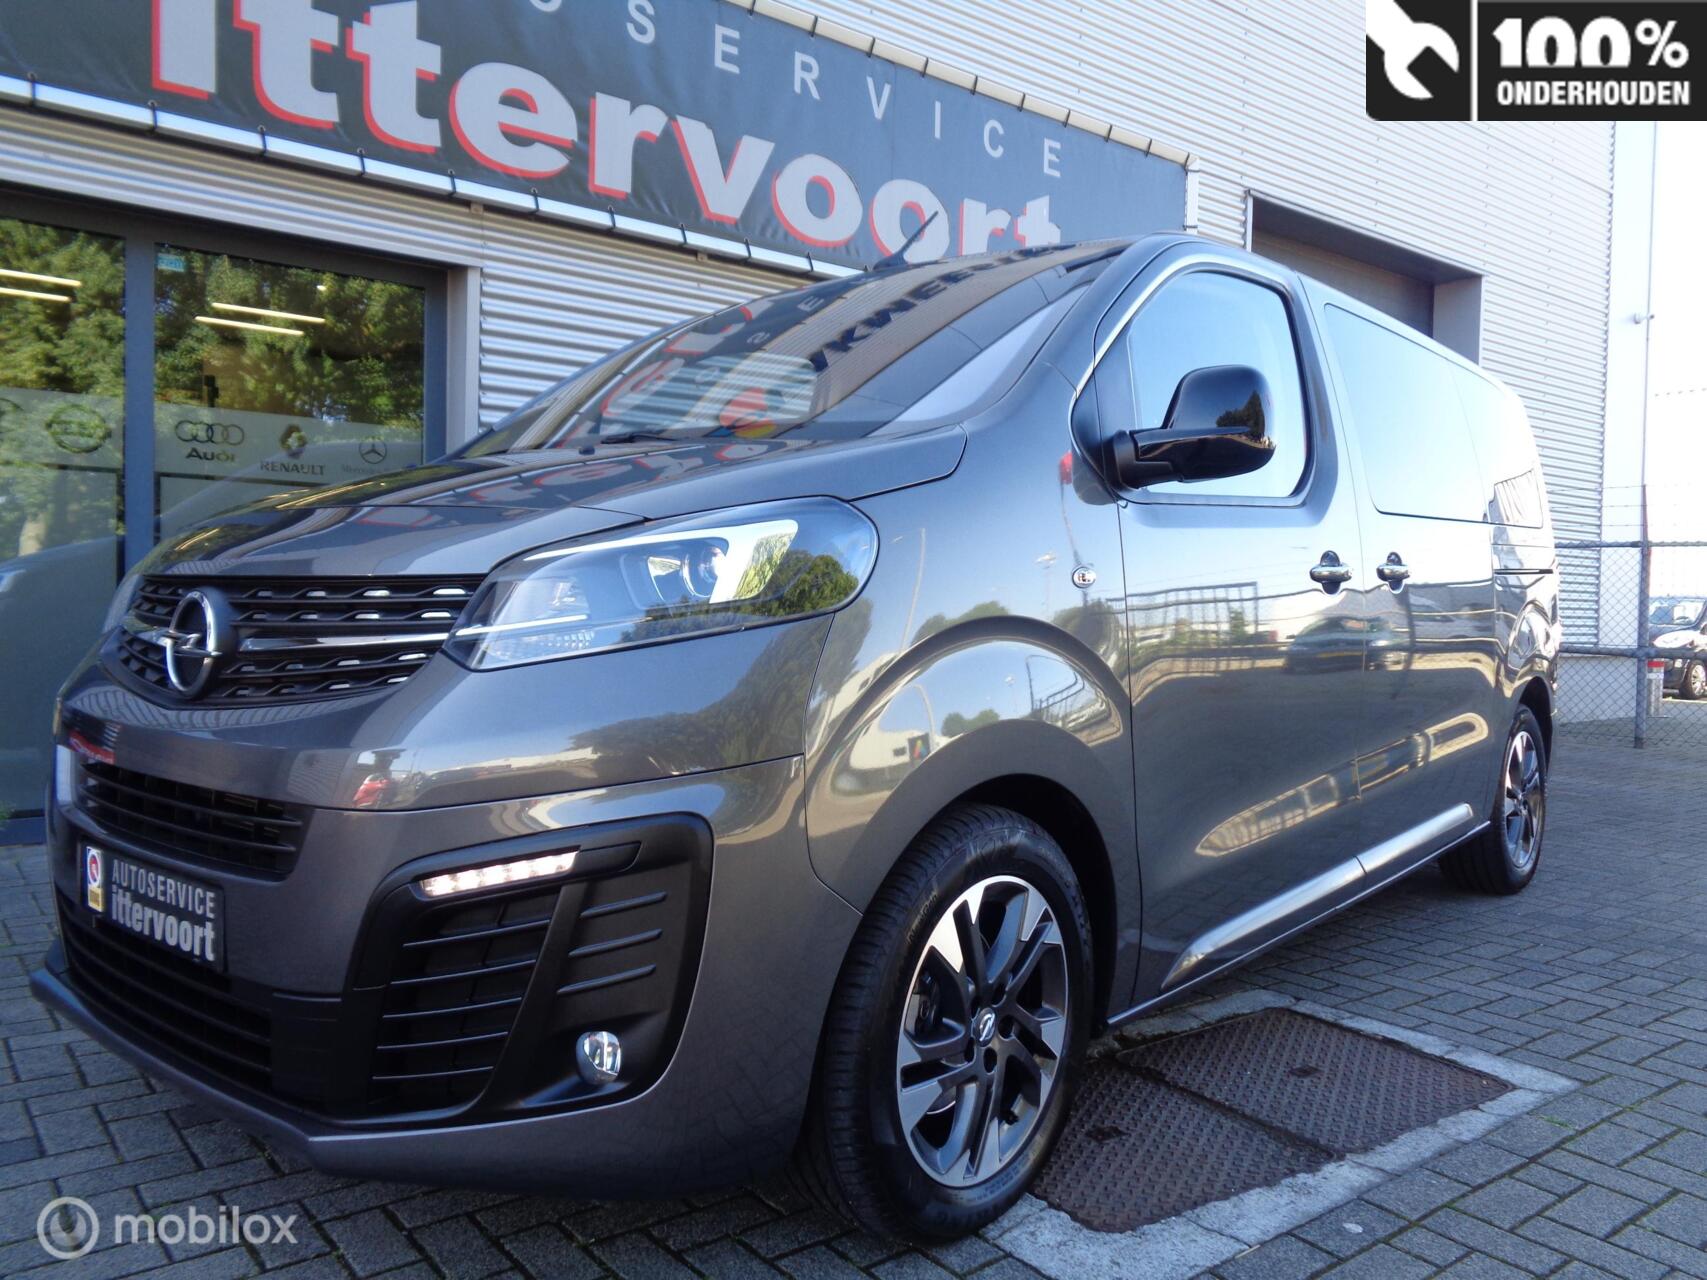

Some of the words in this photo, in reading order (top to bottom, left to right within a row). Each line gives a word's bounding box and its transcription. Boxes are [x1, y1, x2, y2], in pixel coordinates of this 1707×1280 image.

[260, 461, 325, 476] RENAULT
[111, 859, 215, 919] AUTOSERVICE
[111, 885, 215, 961] ittervoort
